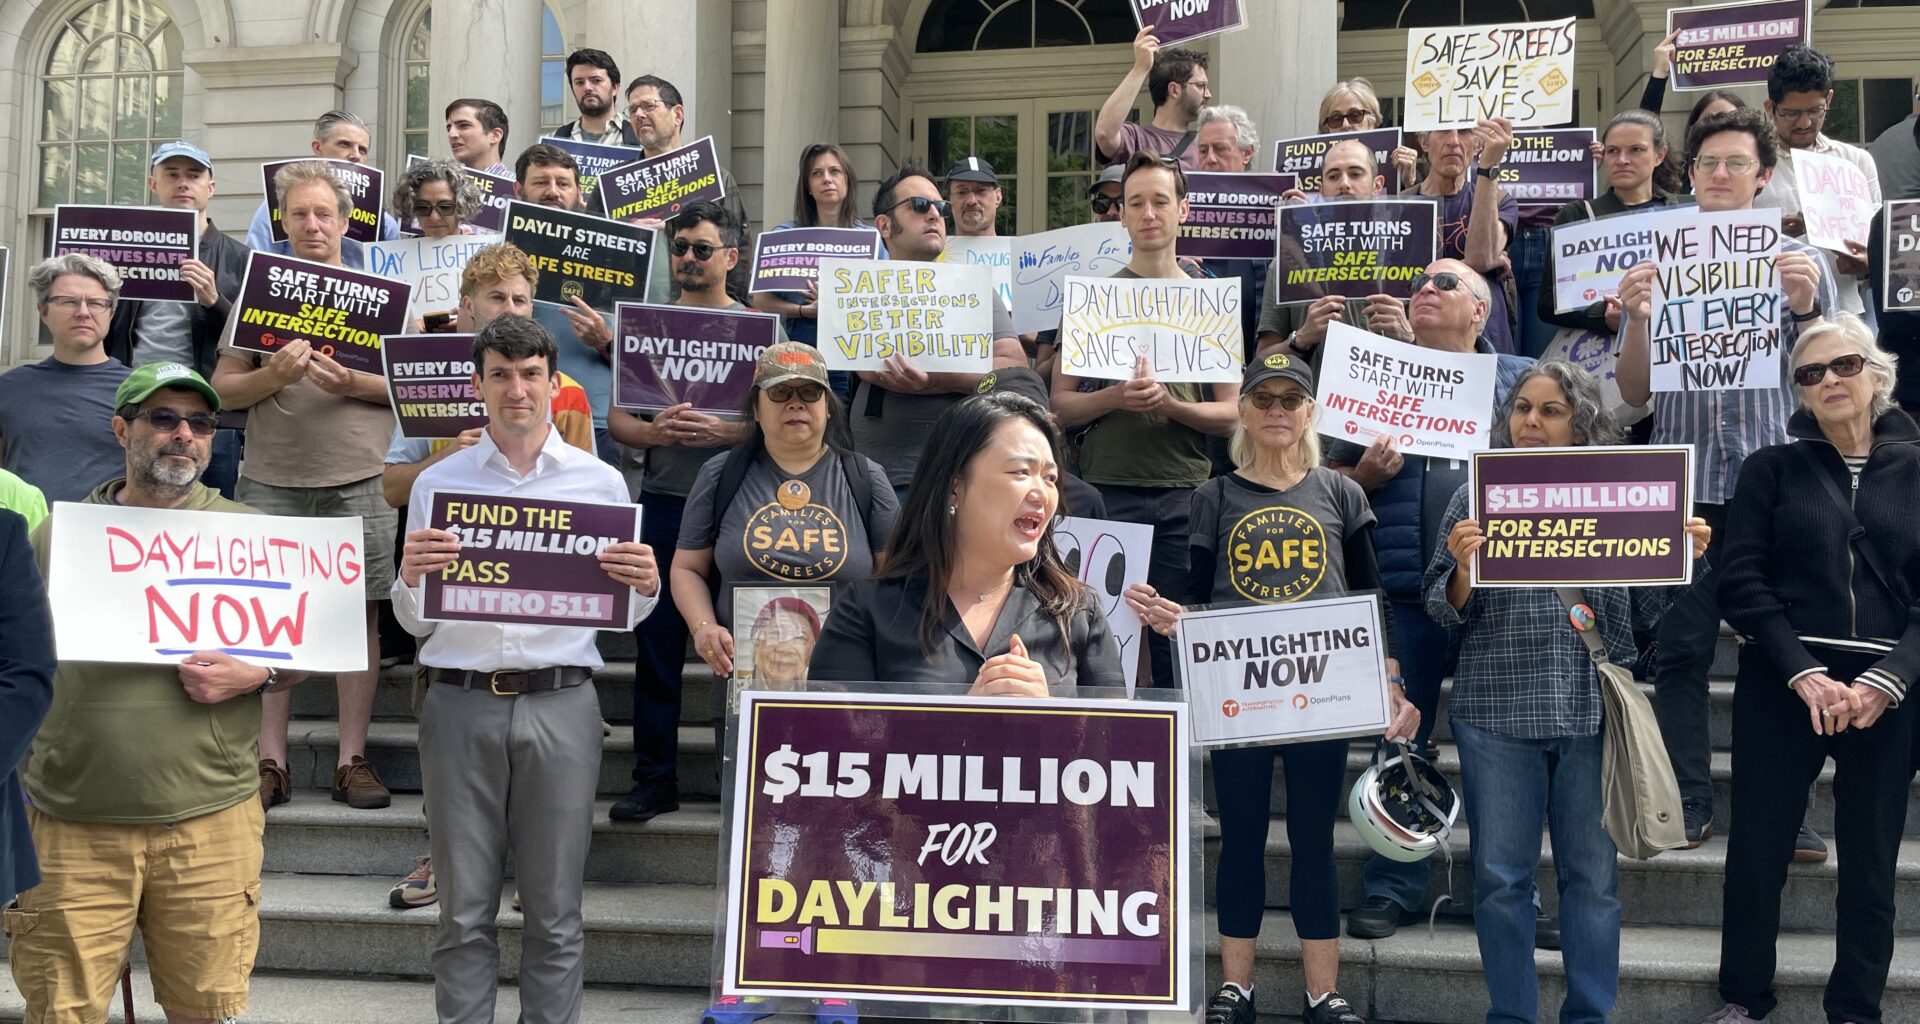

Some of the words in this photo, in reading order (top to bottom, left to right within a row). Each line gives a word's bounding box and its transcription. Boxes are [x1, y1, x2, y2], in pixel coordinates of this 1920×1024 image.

[1170, 0, 1210, 20] NOW
[1422, 33, 1481, 66] SAFE
[1479, 20, 1577, 61] STREETS
[1678, 29, 1710, 46] $15
[1713, 21, 1794, 41] MILLION
[1676, 49, 1705, 63] FOR
[1707, 45, 1746, 60] SAFE
[1677, 55, 1779, 75] INTERSECTIO
[1453, 64, 1519, 92] SAVE
[1439, 90, 1536, 123] LIVES
[1285, 142, 1327, 158] FUND
[1524, 136, 1554, 149] THE
[615, 168, 652, 187] SAFE
[653, 150, 700, 172] TURNS
[1283, 156, 1312, 172] $15
[1510, 149, 1584, 163] MILLION
[331, 167, 370, 187] URNS
[621, 174, 661, 196] START
[664, 161, 698, 181] WITH
[646, 178, 680, 199] SAFE
[1297, 176, 1321, 191] ASS
[350, 183, 366, 198] TH
[612, 174, 716, 220] INTERSECTIONS
[1218, 193, 1283, 206] BOROUG
[1501, 184, 1542, 198] TRO
[1545, 184, 1578, 198] 511
[1188, 210, 1247, 224] SERVES
[1247, 212, 1276, 225] SAF
[1301, 222, 1346, 238] SAFE
[1350, 220, 1412, 236] TURNS
[61, 228, 109, 242] EVERY
[112, 230, 188, 245] BOROUGH
[512, 216, 572, 239] DAYLIT
[575, 229, 647, 255] STREETS
[1303, 236, 1356, 252] START
[1360, 236, 1404, 251] WITH
[1562, 230, 1652, 258] DAYLIGH
[1654, 226, 1698, 262] WE
[1711, 224, 1779, 259] NEED
[370, 246, 407, 276] DAY
[561, 245, 591, 260] ARE
[763, 243, 805, 254] EVERY
[806, 243, 871, 253] BOROUGH
[966, 249, 1010, 266] DAYLIG
[1038, 246, 1080, 268] Families
[1333, 251, 1379, 266] SAFE
[528, 255, 559, 273] AFE
[562, 261, 635, 287] STREETS
[758, 267, 819, 278] INTERSE
[760, 256, 819, 268] DESERV
[268, 266, 320, 292] SAFE
[323, 276, 390, 304] TURNS
[835, 268, 936, 294] SAFER
[1656, 256, 1778, 300] VISIBILITY
[269, 282, 330, 306] START
[333, 295, 381, 318] WITH
[563, 287, 581, 296] SAFE
[837, 294, 980, 308] INTERSECTIONS
[1068, 281, 1238, 319] DAYLIGHTING
[298, 303, 350, 325] SAFE
[847, 309, 944, 332] BETER
[1655, 299, 1694, 337] AT
[1703, 292, 1778, 331] EVERY
[242, 307, 381, 350] INTERSECTION
[834, 331, 992, 360] VISIBILITY
[1070, 328, 1138, 369] SAVES
[1153, 332, 1232, 374] LIVES
[393, 361, 448, 376] EVERY
[660, 357, 734, 384] NOW
[1349, 346, 1393, 372] SAFE
[1398, 360, 1464, 384] TURNS
[1681, 357, 1748, 391] NOW!
[395, 384, 474, 399] DESERVE
[1349, 363, 1401, 391] START
[1406, 379, 1454, 400] WITH
[400, 402, 488, 417] INTERSECT
[1326, 392, 1477, 435] INTERSECTIONS
[1376, 390, 1424, 412] SAFE
[1416, 438, 1455, 449] OpenPlans
[1488, 486, 1539, 512] $15
[1544, 485, 1669, 508] MILLION
[446, 502, 518, 526] FUND
[523, 507, 573, 531] THE
[761, 509, 832, 526] FAMILIES
[1237, 513, 1313, 540] FAMILIES
[1486, 519, 1533, 538] FOR
[1538, 518, 1598, 537] SAFE
[496, 529, 619, 556] MILLION
[751, 525, 840, 552] SAFE
[1487, 538, 1671, 558] INTERSECTIONS
[106, 526, 361, 585] DAYLIGHTING
[760, 554, 833, 577] STREETS
[1234, 539, 1319, 573] SAFE
[441, 559, 510, 584] PASS
[1241, 574, 1311, 598] STREETS
[444, 588, 545, 616] INTRO
[551, 594, 602, 617] 511
[145, 585, 309, 647] NOW
[1192, 627, 1370, 663] DAYLIGHTING
[1243, 654, 1329, 690] NOW
[1310, 694, 1351, 705] OpenPlans
[763, 744, 871, 803] $15
[882, 753, 1155, 808] MILLION
[917, 821, 998, 867] FOR
[757, 878, 1160, 937] DAYLIGHTING
